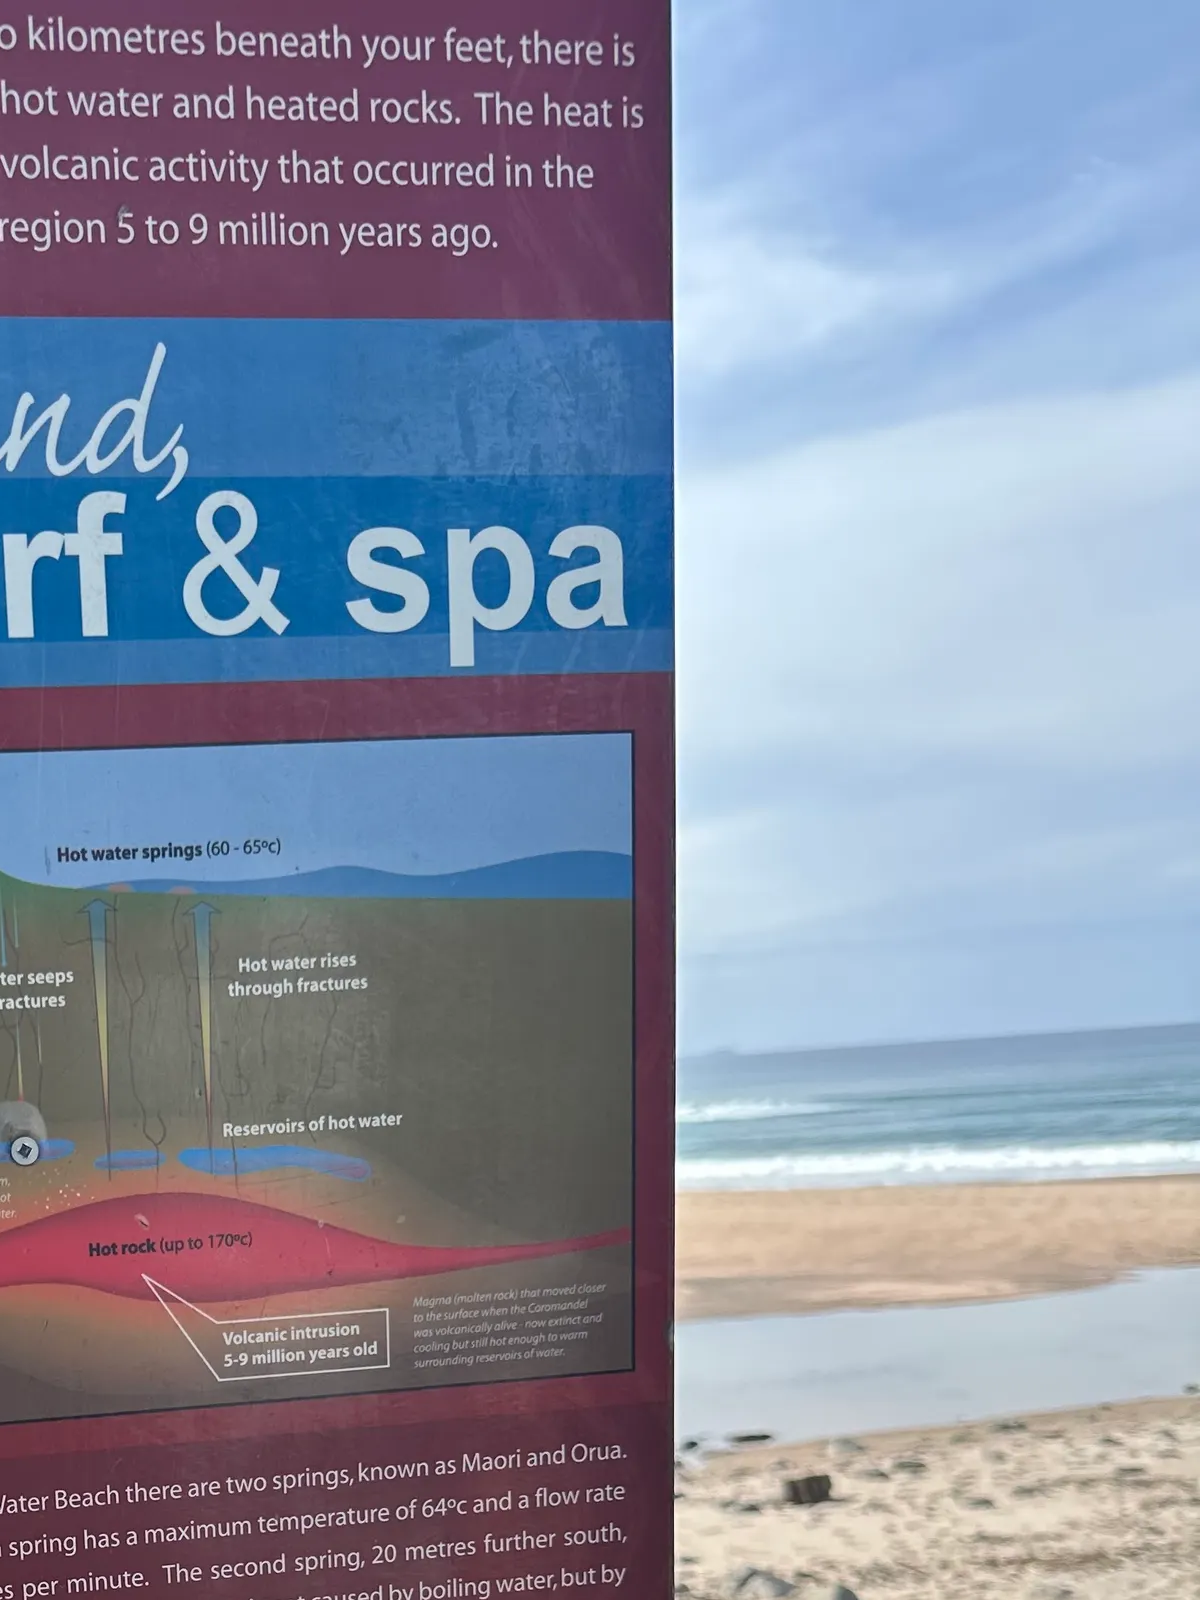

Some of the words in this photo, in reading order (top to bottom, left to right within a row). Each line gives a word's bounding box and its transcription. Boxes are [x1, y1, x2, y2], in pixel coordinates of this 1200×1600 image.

[27, 14, 205, 55] kilometres
[215, 20, 351, 59] beneath
[361, 34, 435, 68] your
[443, 26, 513, 68] feet,
[518, 28, 603, 65] there
[613, 32, 635, 66] is
[0, 78, 58, 115] hot
[66, 87, 163, 117] water
[172, 84, 234, 119] and
[245, 84, 358, 122] heated
[370, 88, 461, 124] rocks.
[473, 90, 533, 125] The
[543, 91, 612, 128] heat
[622, 95, 643, 128] is
[117, 212, 134, 243] 5
[144, 215, 179, 244] to
[188, 212, 208, 244] 9
[218, 211, 328, 245] million
[338, 222, 421, 255] years
[431, 223, 498, 256] ago.
[182, 489, 291, 636] &
[345, 522, 629, 668] spa
[56, 846, 88, 863] Hot
[90, 845, 139, 861] water
[141, 841, 202, 863] springs
[205, 840, 230, 858] (60
[237, 957, 267, 973] Hot
[270, 955, 317, 971] water
[319, 951, 356, 968] rises
[26, 970, 74, 987] seeps
[227, 977, 293, 998] through
[296, 976, 368, 993] fractures
[222, 1117, 305, 1137] Reservoirs
[308, 1114, 325, 1131] of
[327, 1114, 355, 1130] hot
[357, 1112, 403, 1128] water
[88, 1241, 118, 1257] Hot
[120, 1237, 156, 1255] rock
[159, 1236, 184, 1254] (up
[186, 1236, 203, 1250] to
[221, 1326, 287, 1345] Volcanic
[290, 1321, 360, 1340] intrusion
[223, 1352, 248, 1367] 5-9
[251, 1348, 305, 1365] million
[308, 1346, 350, 1364] years
[352, 1340, 377, 1356] old
[54, 1483, 119, 1509] Beach
[124, 1481, 182, 1503] there
[187, 1480, 220, 1497] are
[224, 1476, 267, 1494] two
[272, 1467, 354, 1494] springs,
[357, 1461, 429, 1482] known
[434, 1459, 456, 1475] as
[461, 1448, 520, 1472] Maori
[526, 1443, 565, 1467] and
[570, 1442, 627, 1462] Orua.
[8, 1533, 76, 1560] spring
[83, 1528, 120, 1549] has
[125, 1530, 138, 1546] a
[144, 1519, 251, 1544] maximum
[256, 1506, 389, 1534] temperature
[395, 1498, 417, 1520] of
[472, 1490, 511, 1513] and
[517, 1494, 529, 1509] a
[534, 1486, 580, 1507] flow
[585, 1484, 625, 1503] rate
